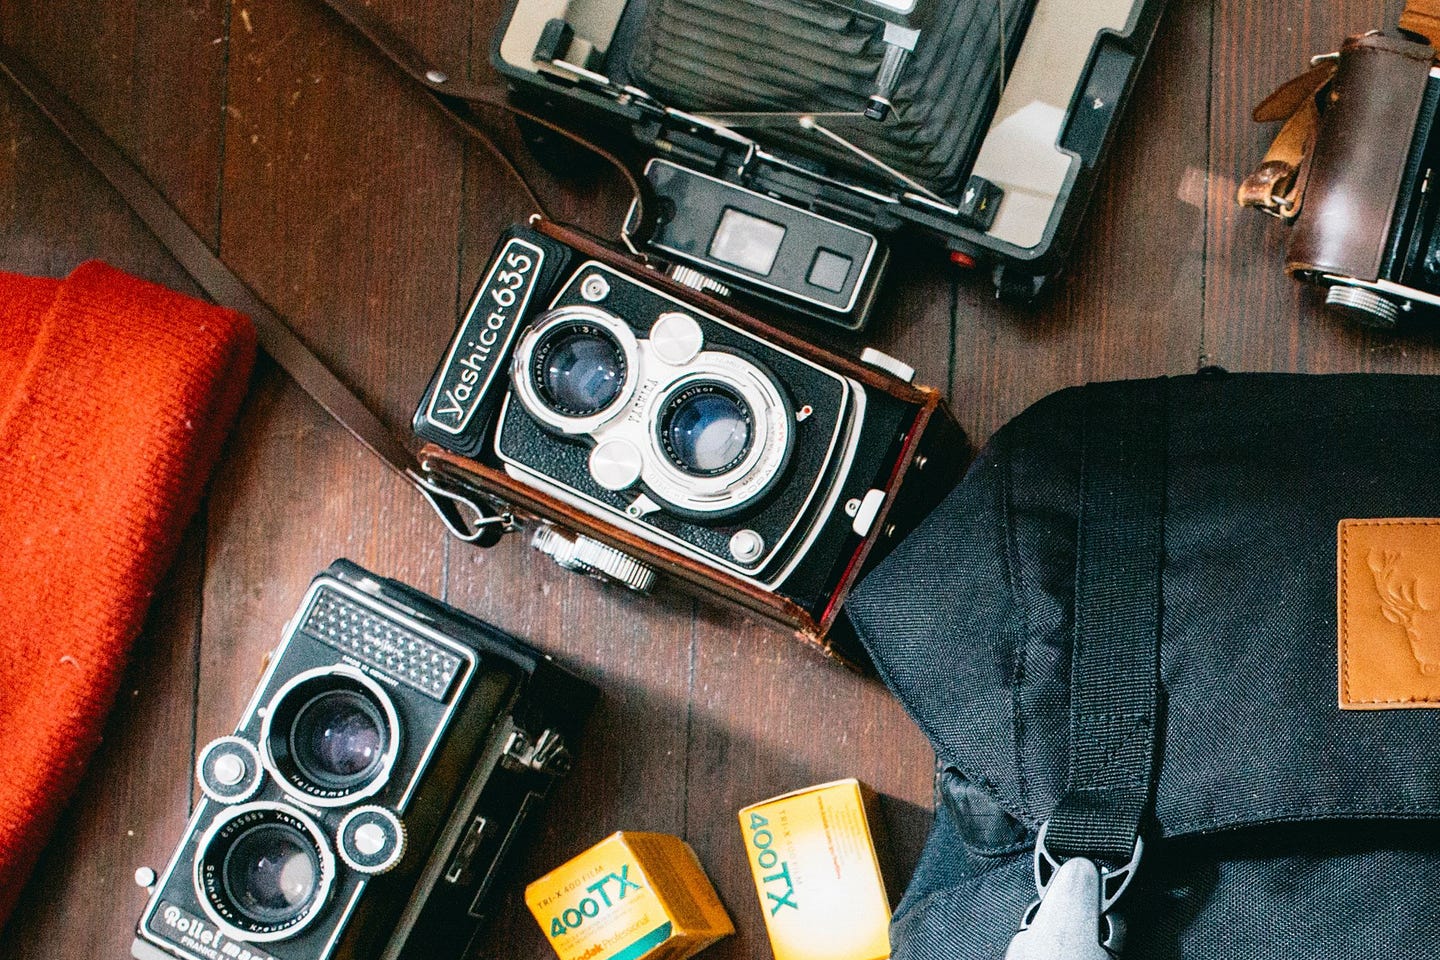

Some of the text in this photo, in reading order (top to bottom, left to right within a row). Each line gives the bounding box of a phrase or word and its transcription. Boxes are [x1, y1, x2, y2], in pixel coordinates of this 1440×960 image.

[437, 253, 532, 421] Yashica-635
[537, 343, 551, 389] Yashikor
[670, 387, 714, 408] Yashikor
[750, 812, 798, 917] 400TX
[206, 865, 233, 918] Schneider
[537, 890, 562, 910] TRI-X
[550, 864, 641, 938] 400TX
[181, 937, 217, 960] FRANKE
